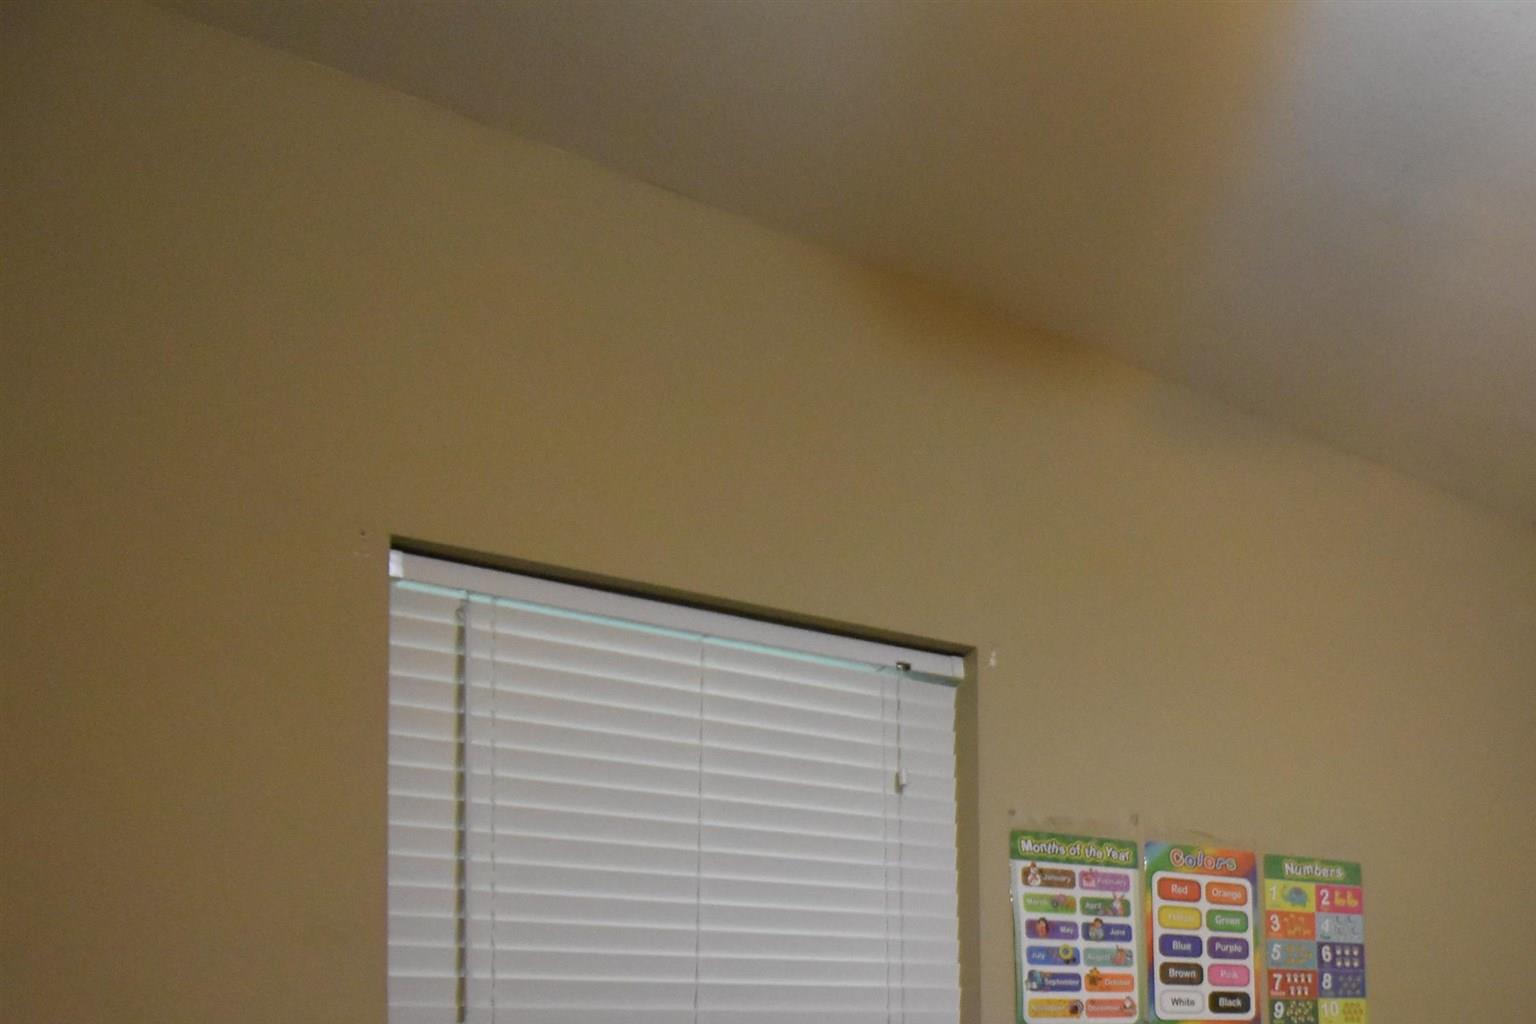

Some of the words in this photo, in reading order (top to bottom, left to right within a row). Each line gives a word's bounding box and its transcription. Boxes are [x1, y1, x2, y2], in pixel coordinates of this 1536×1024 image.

[1021, 839, 1065, 855] Months
[1069, 844, 1080, 856] of
[1085, 846, 1103, 859] the
[1106, 846, 1129, 861] Year
[1169, 848, 1237, 871] Colors
[1284, 863, 1344, 879] Numbers
[1170, 884, 1188, 896] Red
[1211, 888, 1242, 900] Orange
[1270, 885, 1277, 900] 1
[1320, 889, 1330, 905] 2
[1215, 915, 1241, 926] Green
[1270, 914, 1281, 932] 3
[1321, 918, 1329, 933] 4
[1172, 940, 1192, 951] Blue
[1215, 942, 1242, 953] Purple
[1271, 944, 1281, 961] 5
[1321, 945, 1332, 962] 6
[1168, 967, 1197, 978] Brown
[1272, 973, 1283, 991] 7
[1322, 972, 1332, 990] 8
[1170, 997, 1196, 1007] White
[1218, 996, 1242, 1008] Black
[1273, 1001, 1284, 1018] 9
[1321, 1002, 1339, 1017] 10
